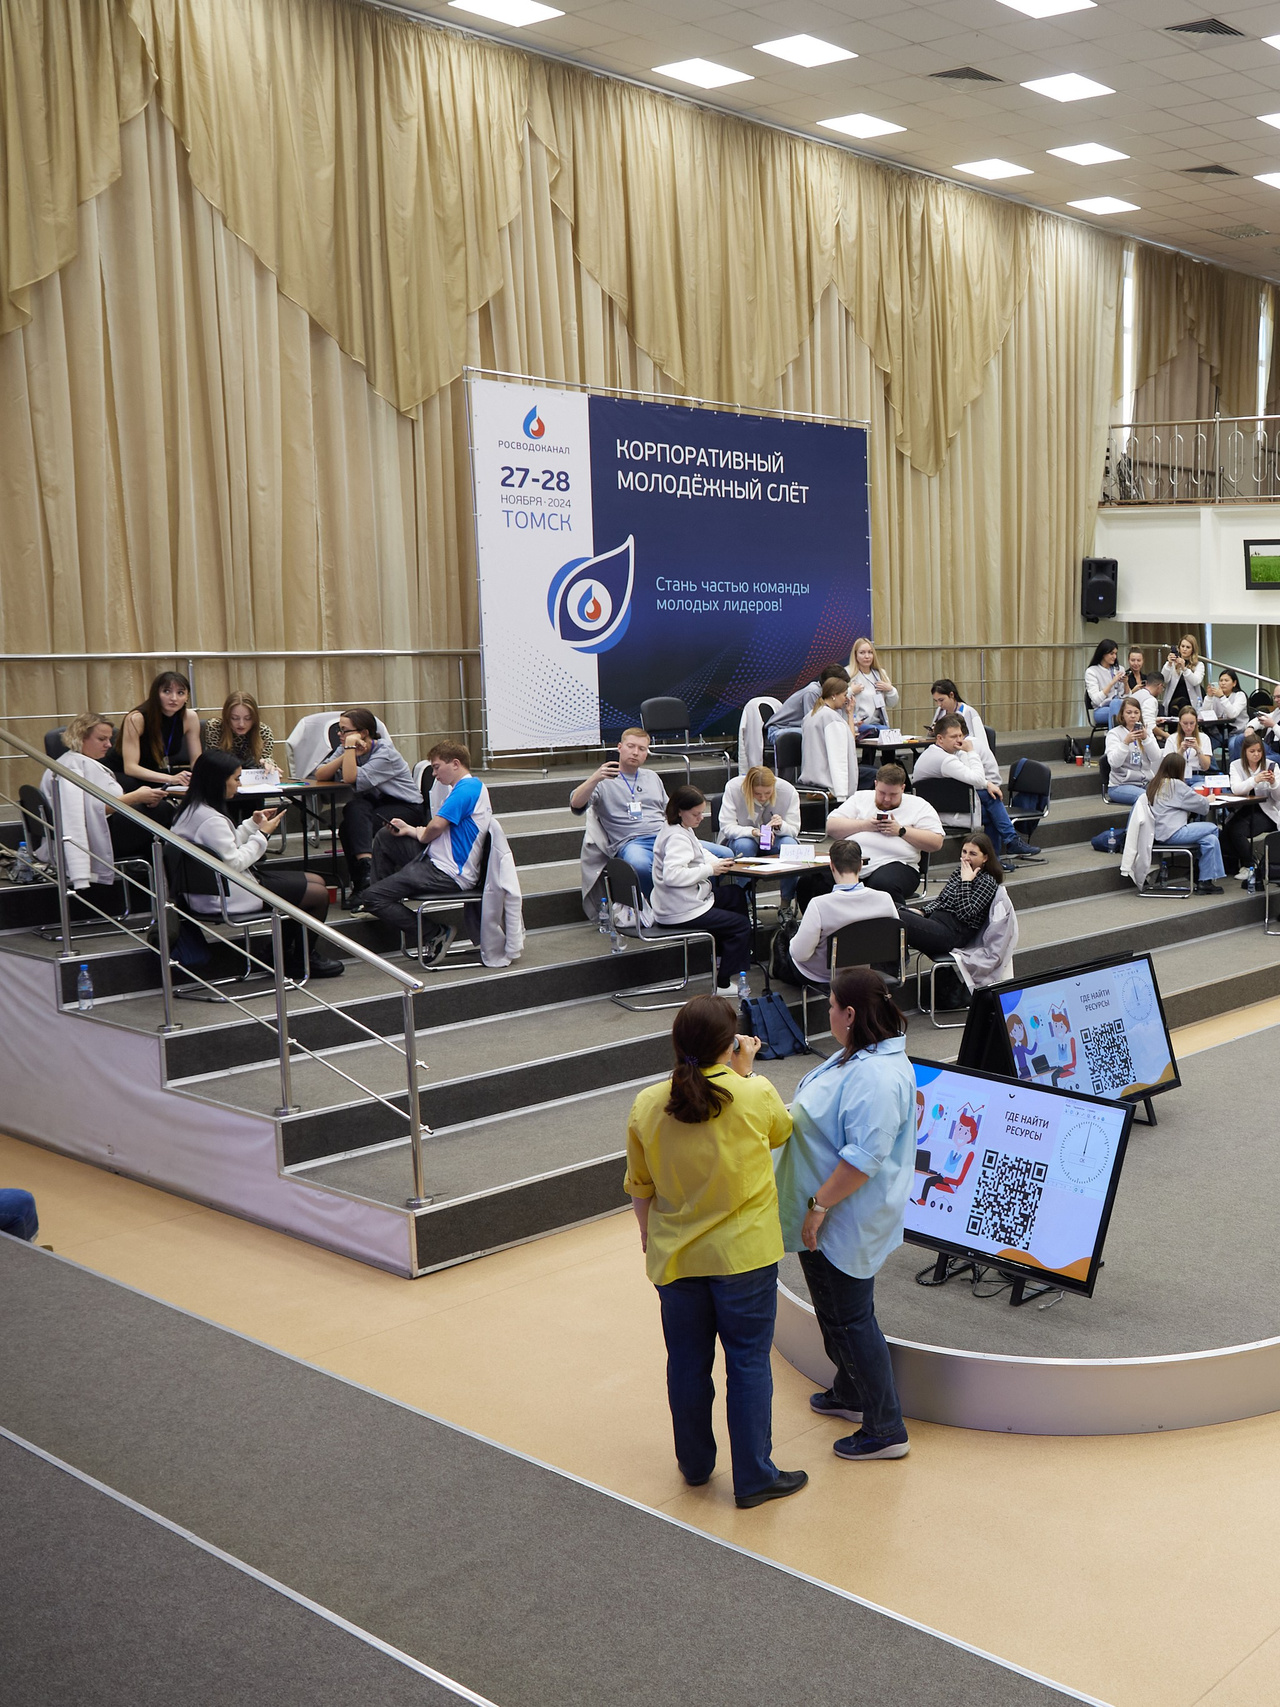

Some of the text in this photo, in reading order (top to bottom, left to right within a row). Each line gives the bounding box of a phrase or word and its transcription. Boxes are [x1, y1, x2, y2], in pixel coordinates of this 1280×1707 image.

[498, 440, 570, 455] РОСВОДОКАНАЛ
[616, 438, 785, 474] КОРПОРАТИВНЫЙ
[500, 465, 570, 492] 27-28
[617, 470, 810, 504] МОЛОДЁЖНЫЙ СЛЁТ
[500, 494, 571, 508] НОЯБРЯ 2024
[501, 509, 572, 531] ТОМСК
[655, 576, 810, 596] Стань частью команды
[656, 597, 783, 615] молодых лидеров!
[1080, 988, 1111, 1004] ГДЕ НАЙТИ
[1084, 999, 1111, 1012] РЕСУРСЫ
[1004, 1110, 1050, 1129] ГДЕ НАЙТИ
[1005, 1124, 1043, 1141] РЕСУРСЫ
